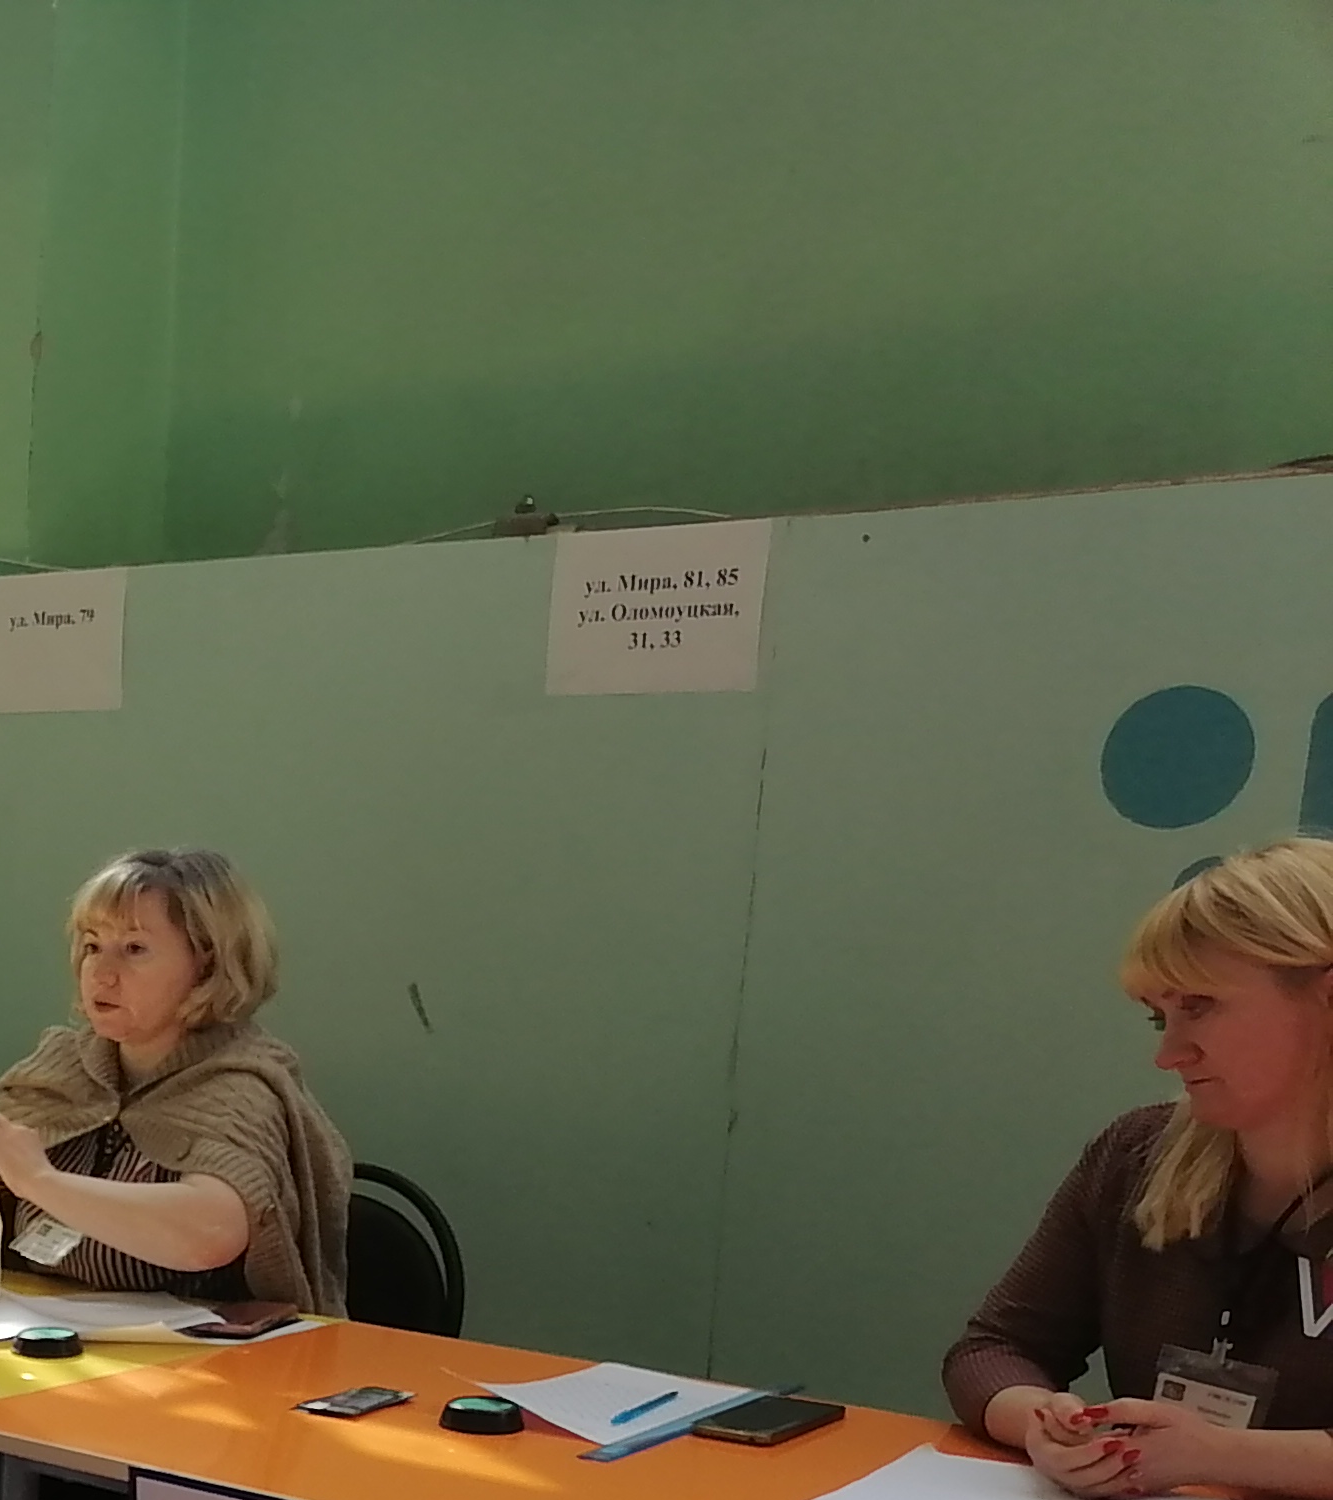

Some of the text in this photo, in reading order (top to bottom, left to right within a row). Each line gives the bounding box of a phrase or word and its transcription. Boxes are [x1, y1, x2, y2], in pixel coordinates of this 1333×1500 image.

[584, 568, 740, 598] ул. Мира, 81, 85
[34, 611, 76, 630] Мира,
[577, 602, 740, 628] ул. Оломоуцкая,
[628, 630, 682, 650] 31, 33
